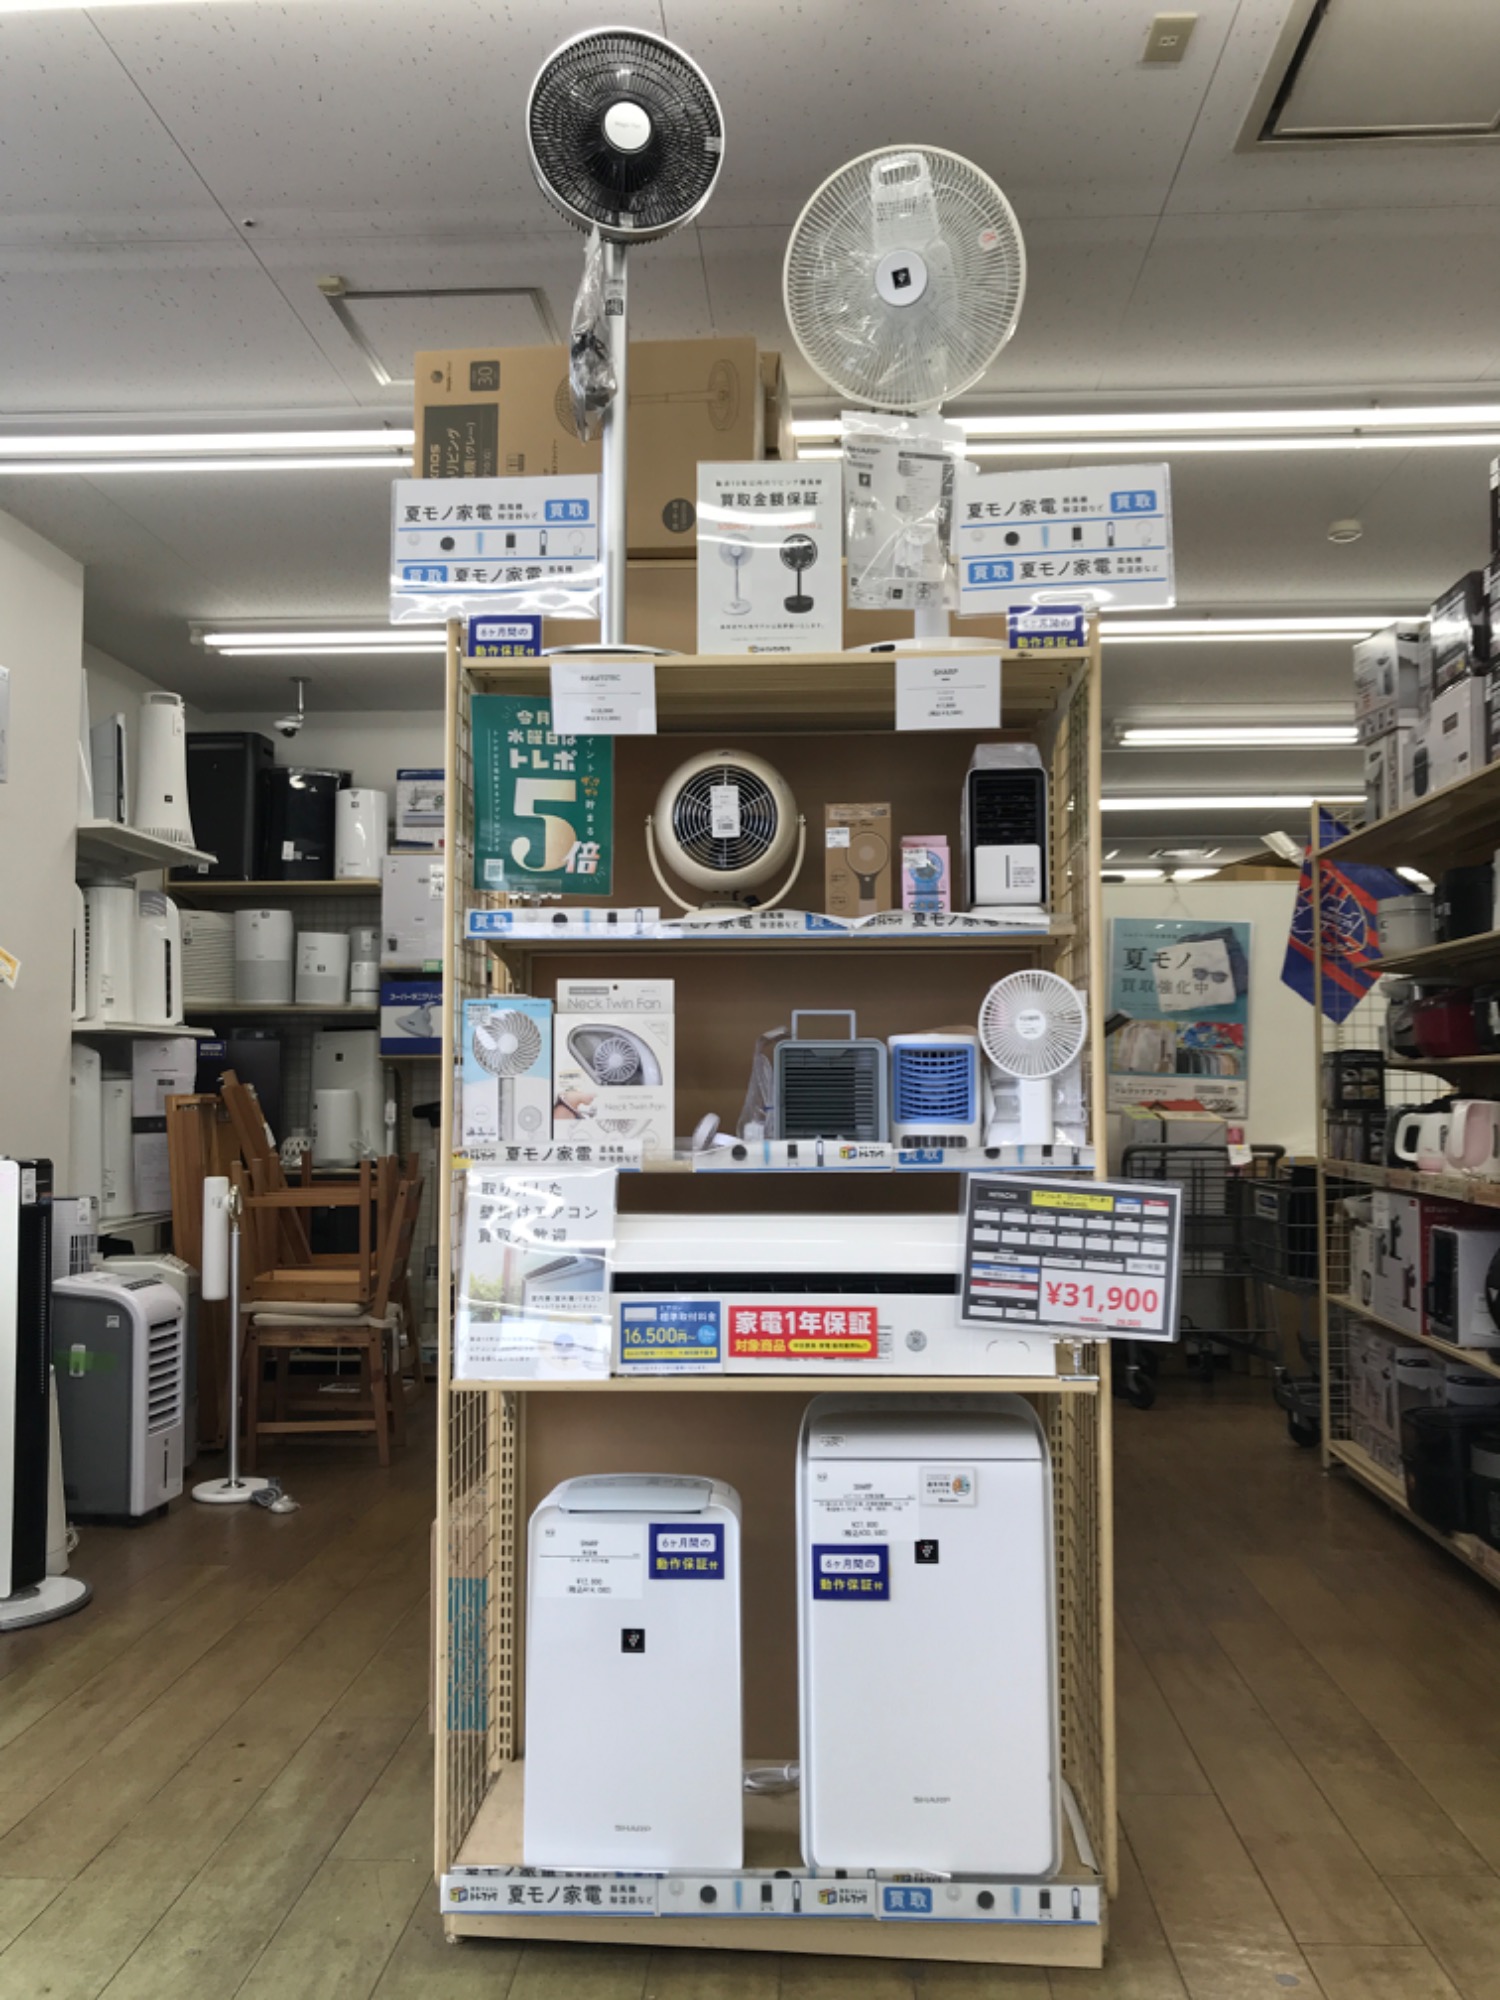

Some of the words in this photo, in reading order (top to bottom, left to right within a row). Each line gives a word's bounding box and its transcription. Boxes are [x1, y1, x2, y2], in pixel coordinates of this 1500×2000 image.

[478, 366, 493, 386] 30
[447, 428, 461, 478] リビング
[404, 503, 493, 522] 夏モノ家電
[550, 502, 585, 519] 買取
[966, 497, 1058, 519] 夏モノ家電
[1116, 493, 1152, 511] 買取
[408, 568, 444, 583] 買取
[454, 566, 543, 584] 夏モノ家電
[973, 564, 1009, 581] 買取
[1019, 557, 1112, 580] 夏モノ家電
[507, 729, 577, 746] 水曜日は
[509, 747, 578, 772] トレポ
[510, 777, 577, 873] 5
[563, 839, 601, 875] 倍
[1122, 947, 1192, 972] 夏モノ
[1121, 977, 1209, 995] 買取強化中
[567, 998, 603, 1009] Neck
[606, 998, 634, 1009] Twin
[636, 998, 662, 1009] Fan
[505, 1145, 592, 1162] 夏モノ家電
[1045, 1280, 1158, 1314] ¥31,900
[735, 1311, 872, 1335] 家電1年保証
[735, 1339, 786, 1353] 対象商品
[662, 1537, 711, 1549] 6ヶ月間の
[656, 1557, 719, 1571] 動作保証付
[825, 1558, 875, 1570] 6ヶ月間の
[819, 1578, 883, 1592] 動作保証付
[913, 1796, 951, 1804] SHARP
[614, 1824, 651, 1832] SHARP
[508, 1884, 602, 1905] 夏モノ家電
[889, 1890, 927, 1909] 買取
